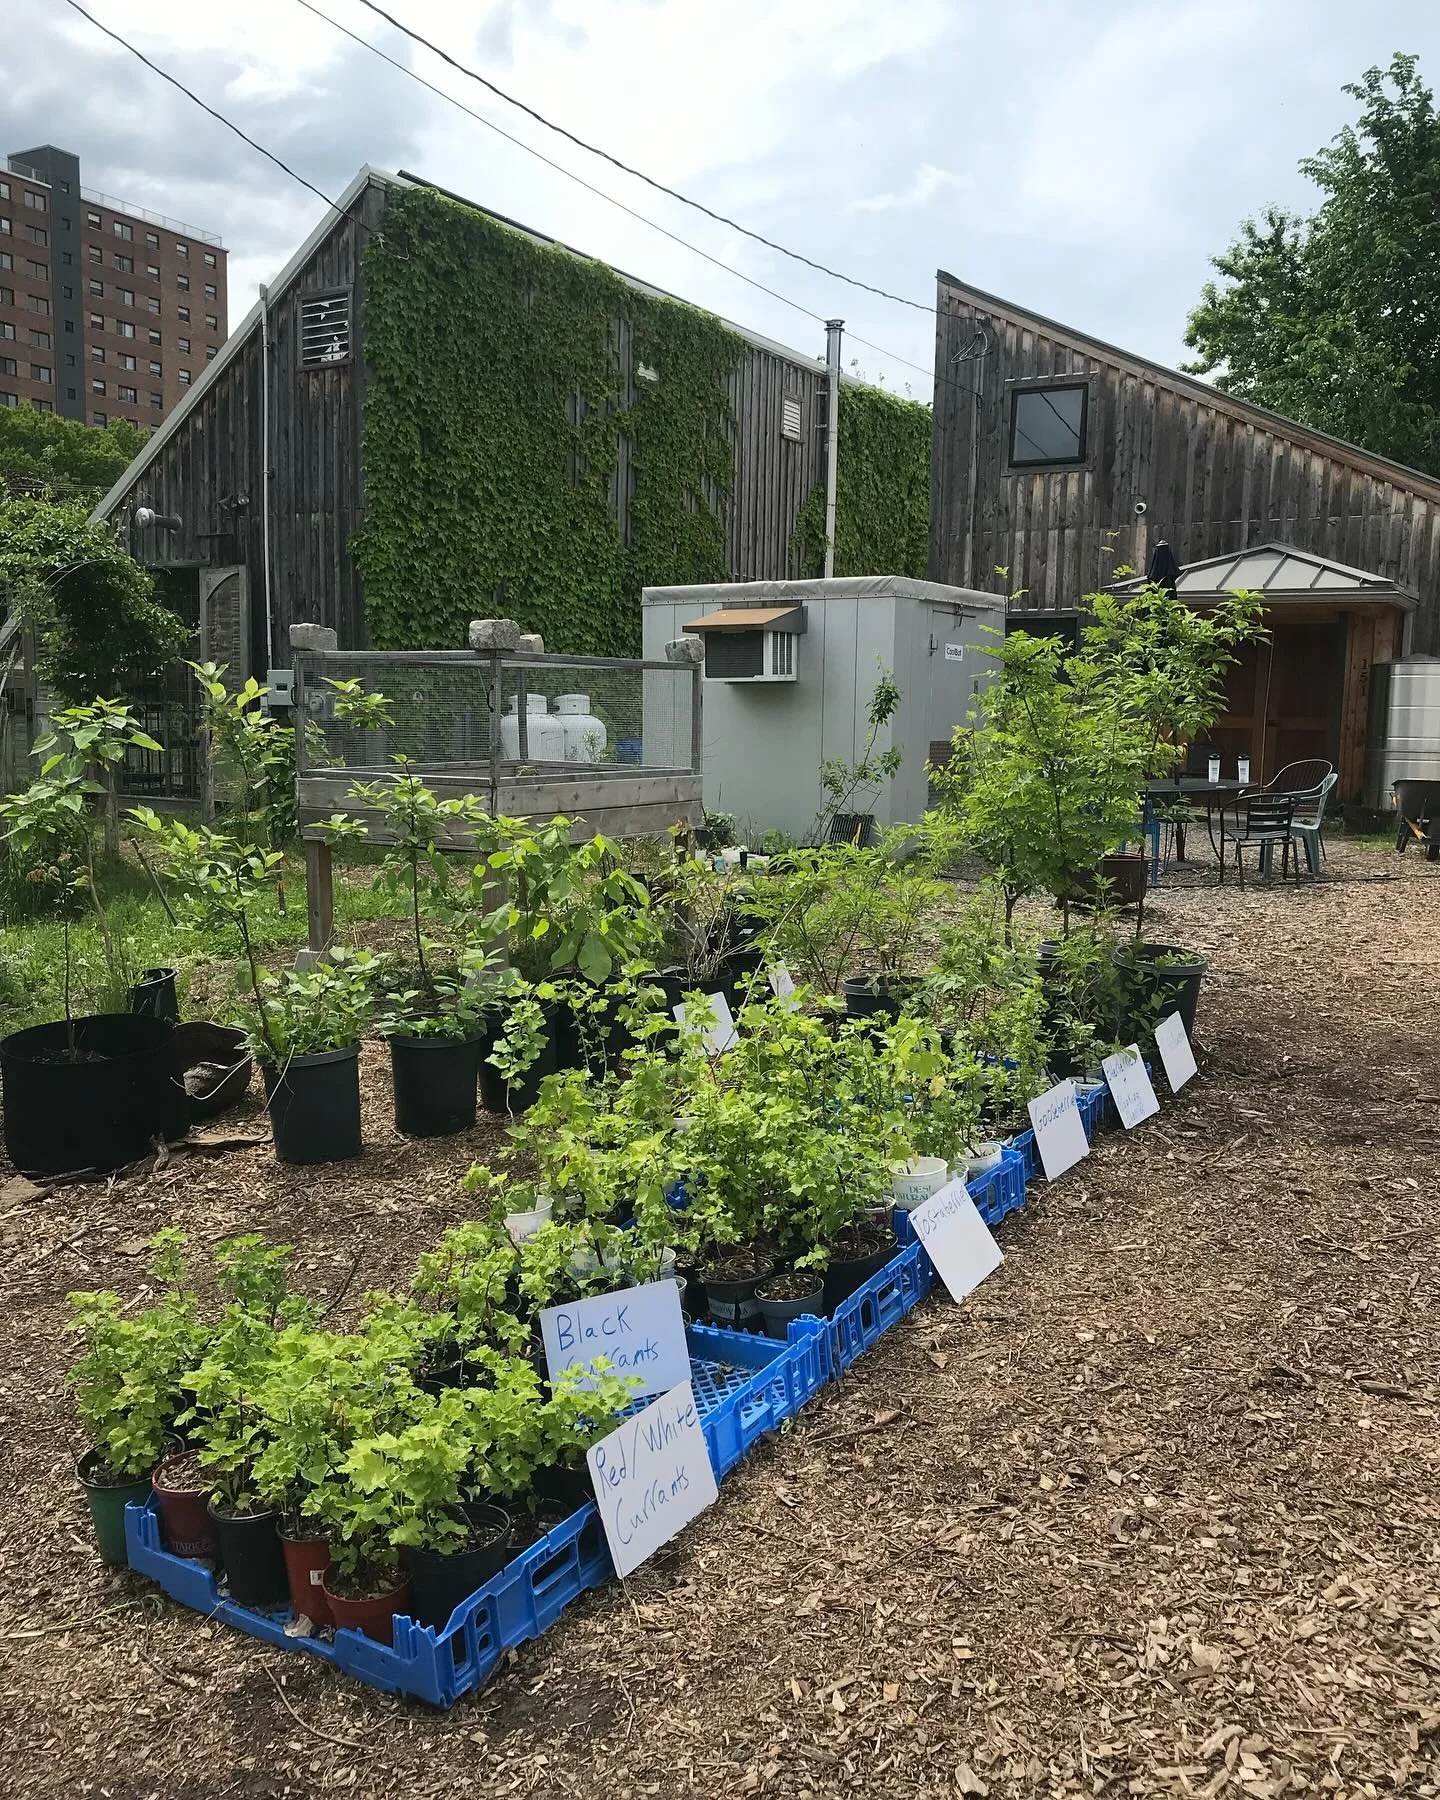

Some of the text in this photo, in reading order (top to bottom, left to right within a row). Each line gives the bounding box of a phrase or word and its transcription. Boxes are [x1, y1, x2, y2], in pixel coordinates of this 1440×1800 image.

[556, 1304, 633, 1352] Black
[565, 1337, 660, 1386] Crants
[595, 1403, 698, 1500] Red/White
[615, 1464, 690, 1545] Currants
